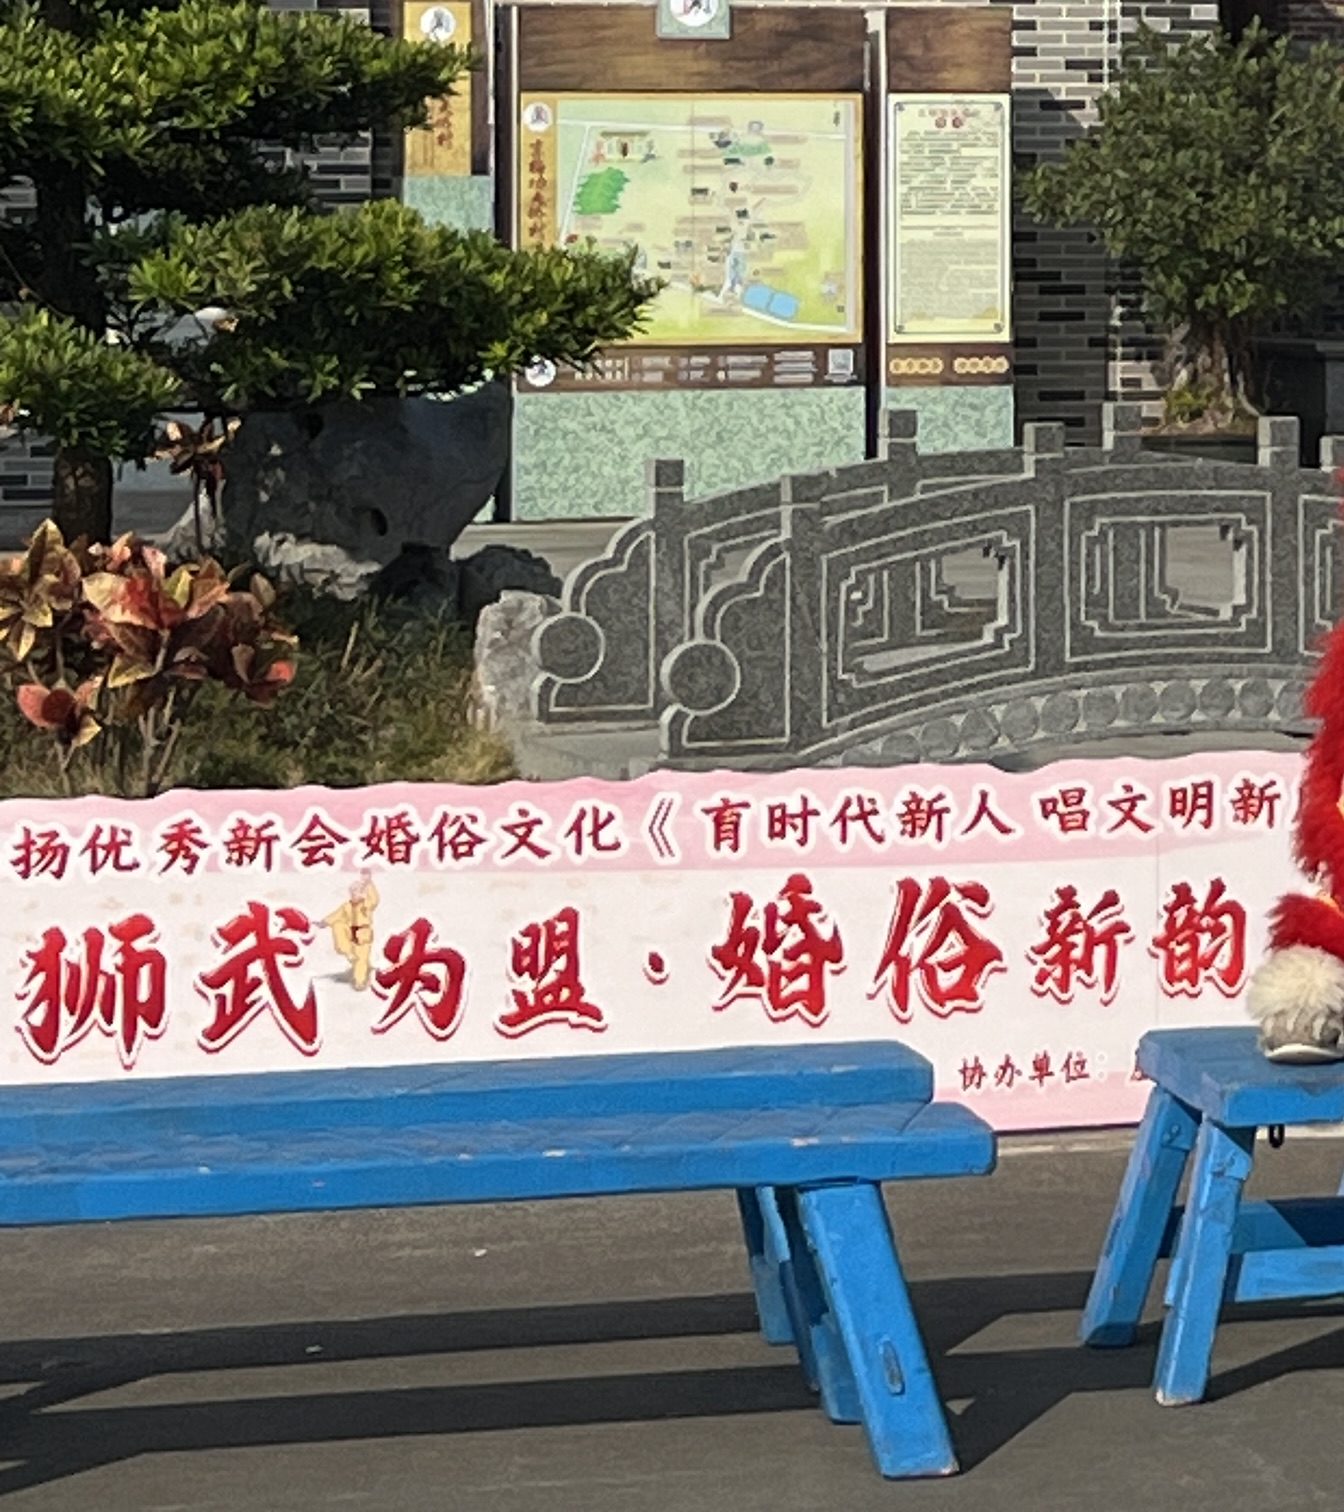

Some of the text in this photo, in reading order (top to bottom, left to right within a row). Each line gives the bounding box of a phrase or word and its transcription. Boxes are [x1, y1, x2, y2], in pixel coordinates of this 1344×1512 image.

[1040, 777, 1299, 835] 唱文明新
[958, 1050, 1148, 1091] 协办单位：
